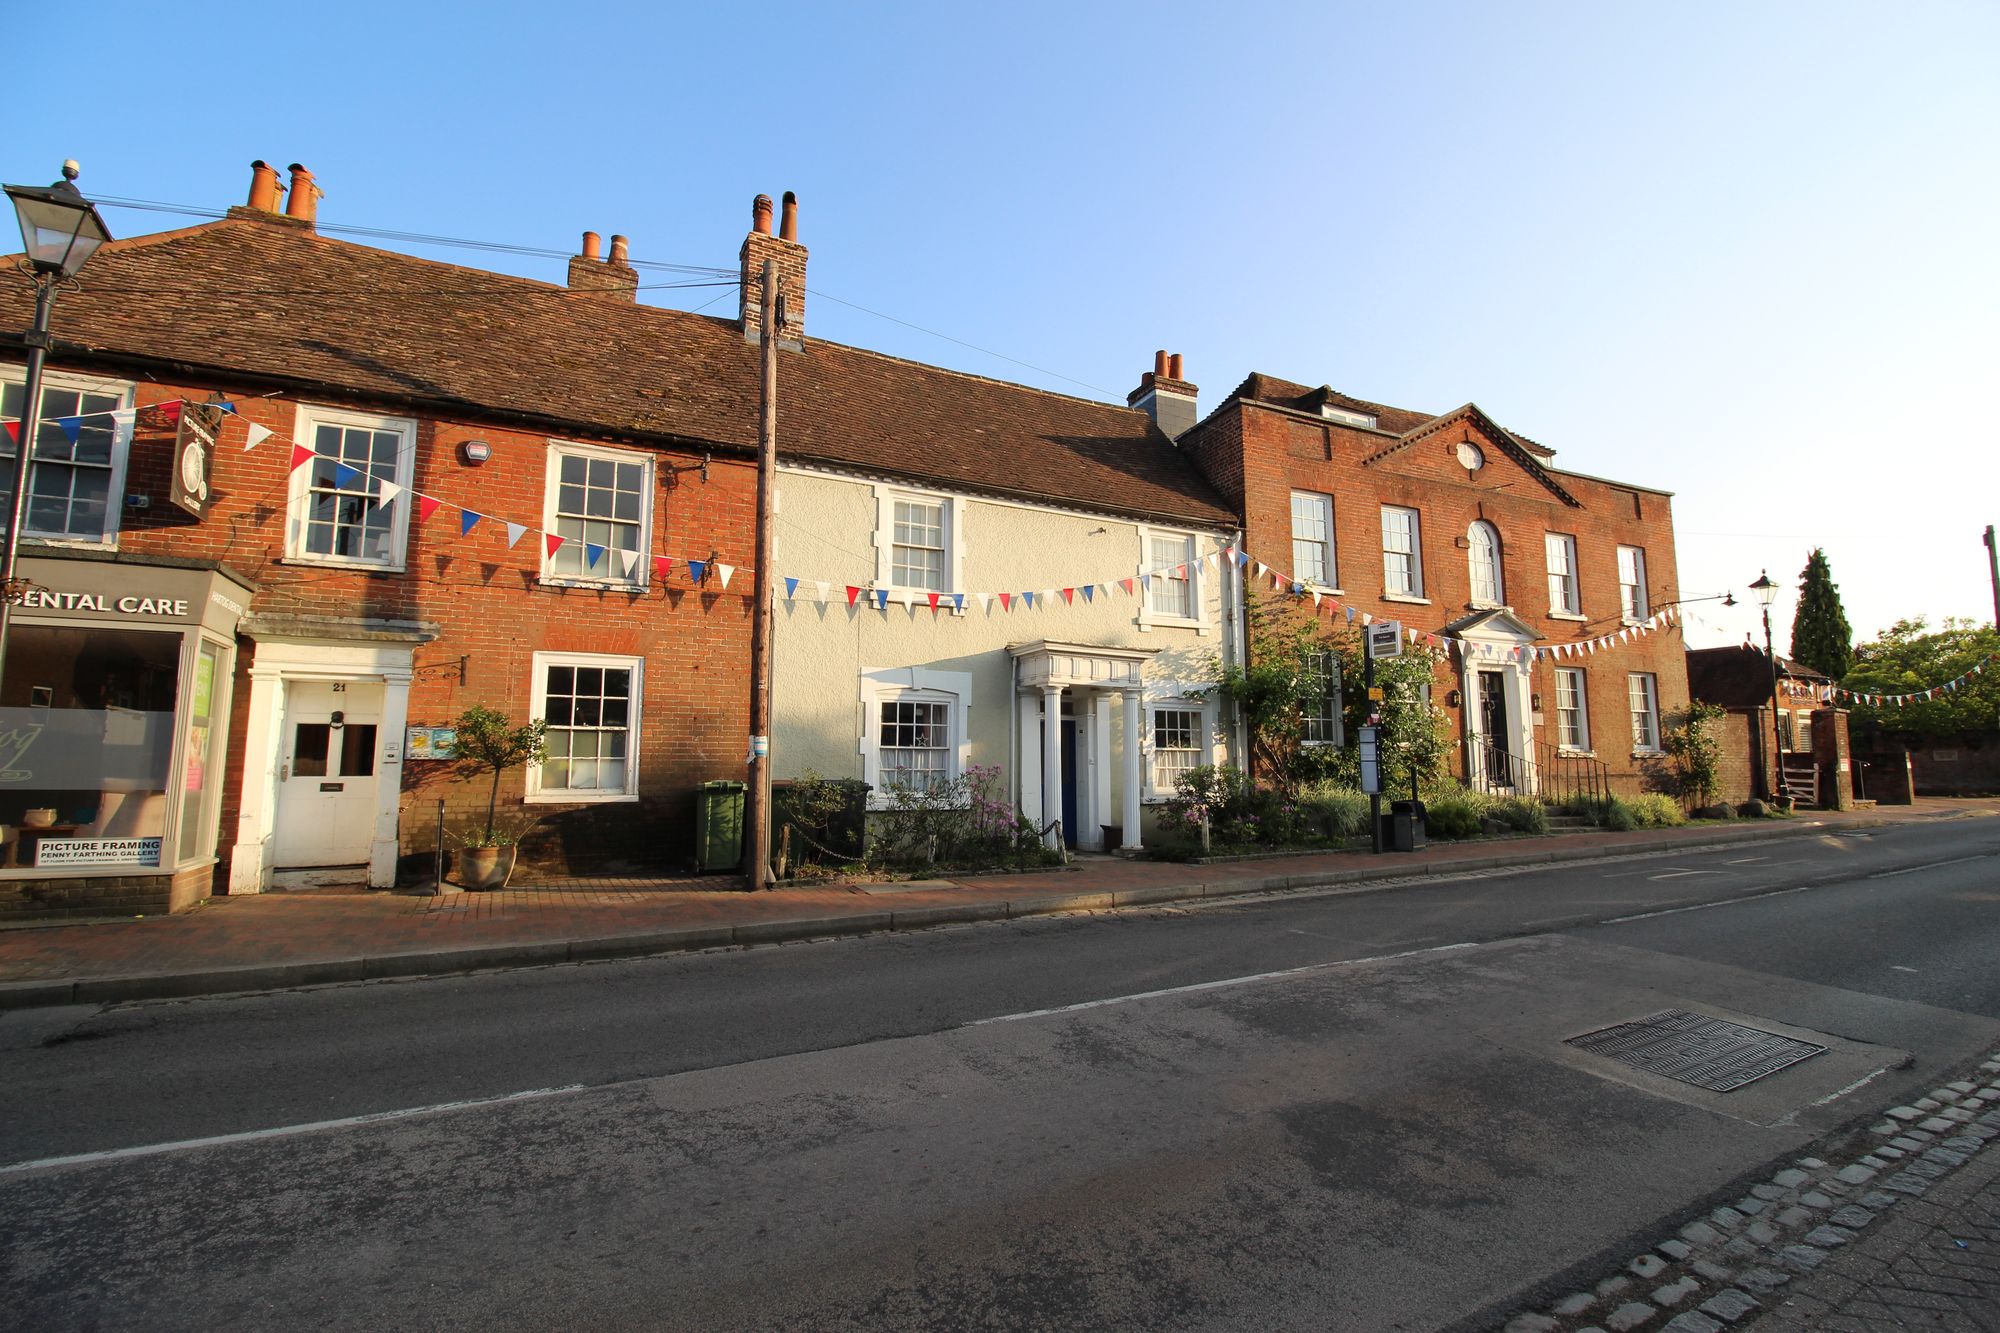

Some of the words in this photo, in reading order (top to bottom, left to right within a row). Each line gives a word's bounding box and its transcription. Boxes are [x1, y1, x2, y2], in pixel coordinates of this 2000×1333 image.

[118, 596, 188, 616] CARE
[333, 682, 345, 692] 21
[41, 842, 98, 851] PICTURE
[102, 841, 160, 850] FRAMING
